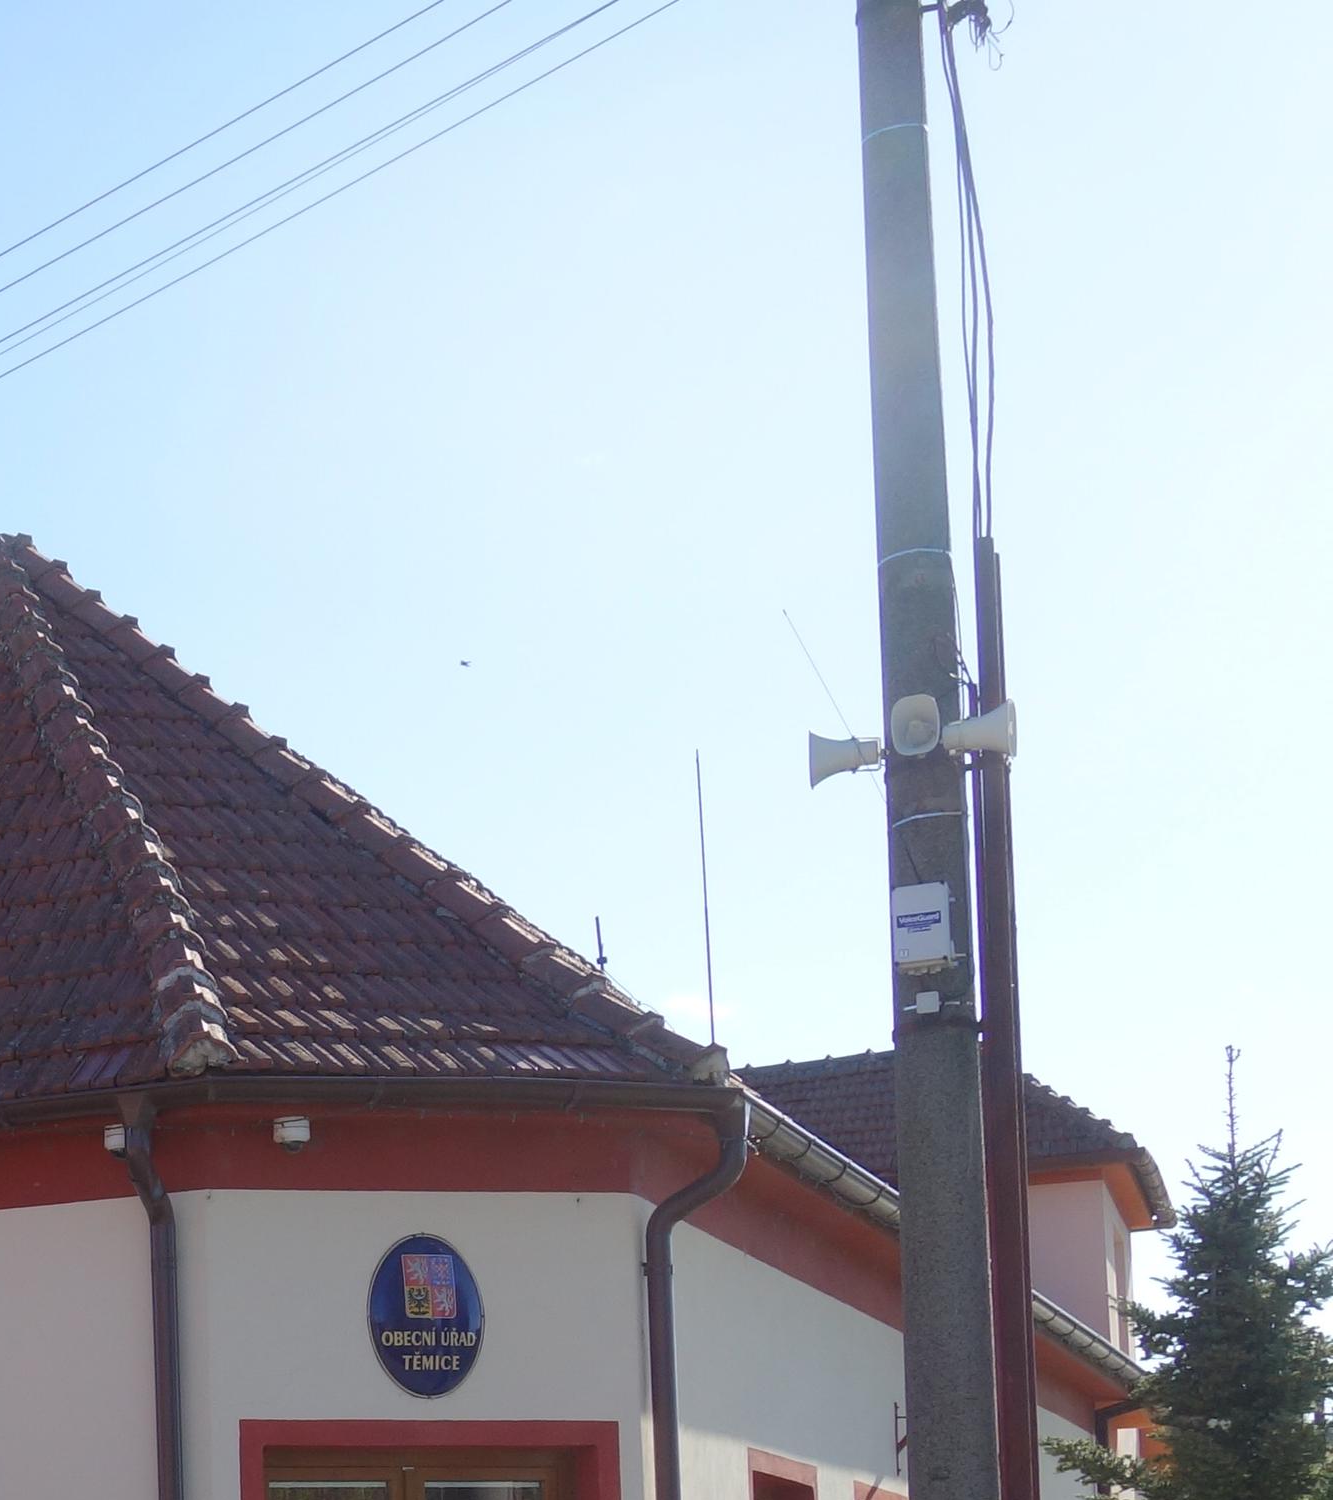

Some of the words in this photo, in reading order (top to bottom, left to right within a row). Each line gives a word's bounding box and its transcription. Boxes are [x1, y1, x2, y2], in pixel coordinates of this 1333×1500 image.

[381, 1327, 436, 1346] OBECNÍ
[440, 1327, 476, 1346] ÚŘAD
[402, 1351, 460, 1370] TĚMICE
